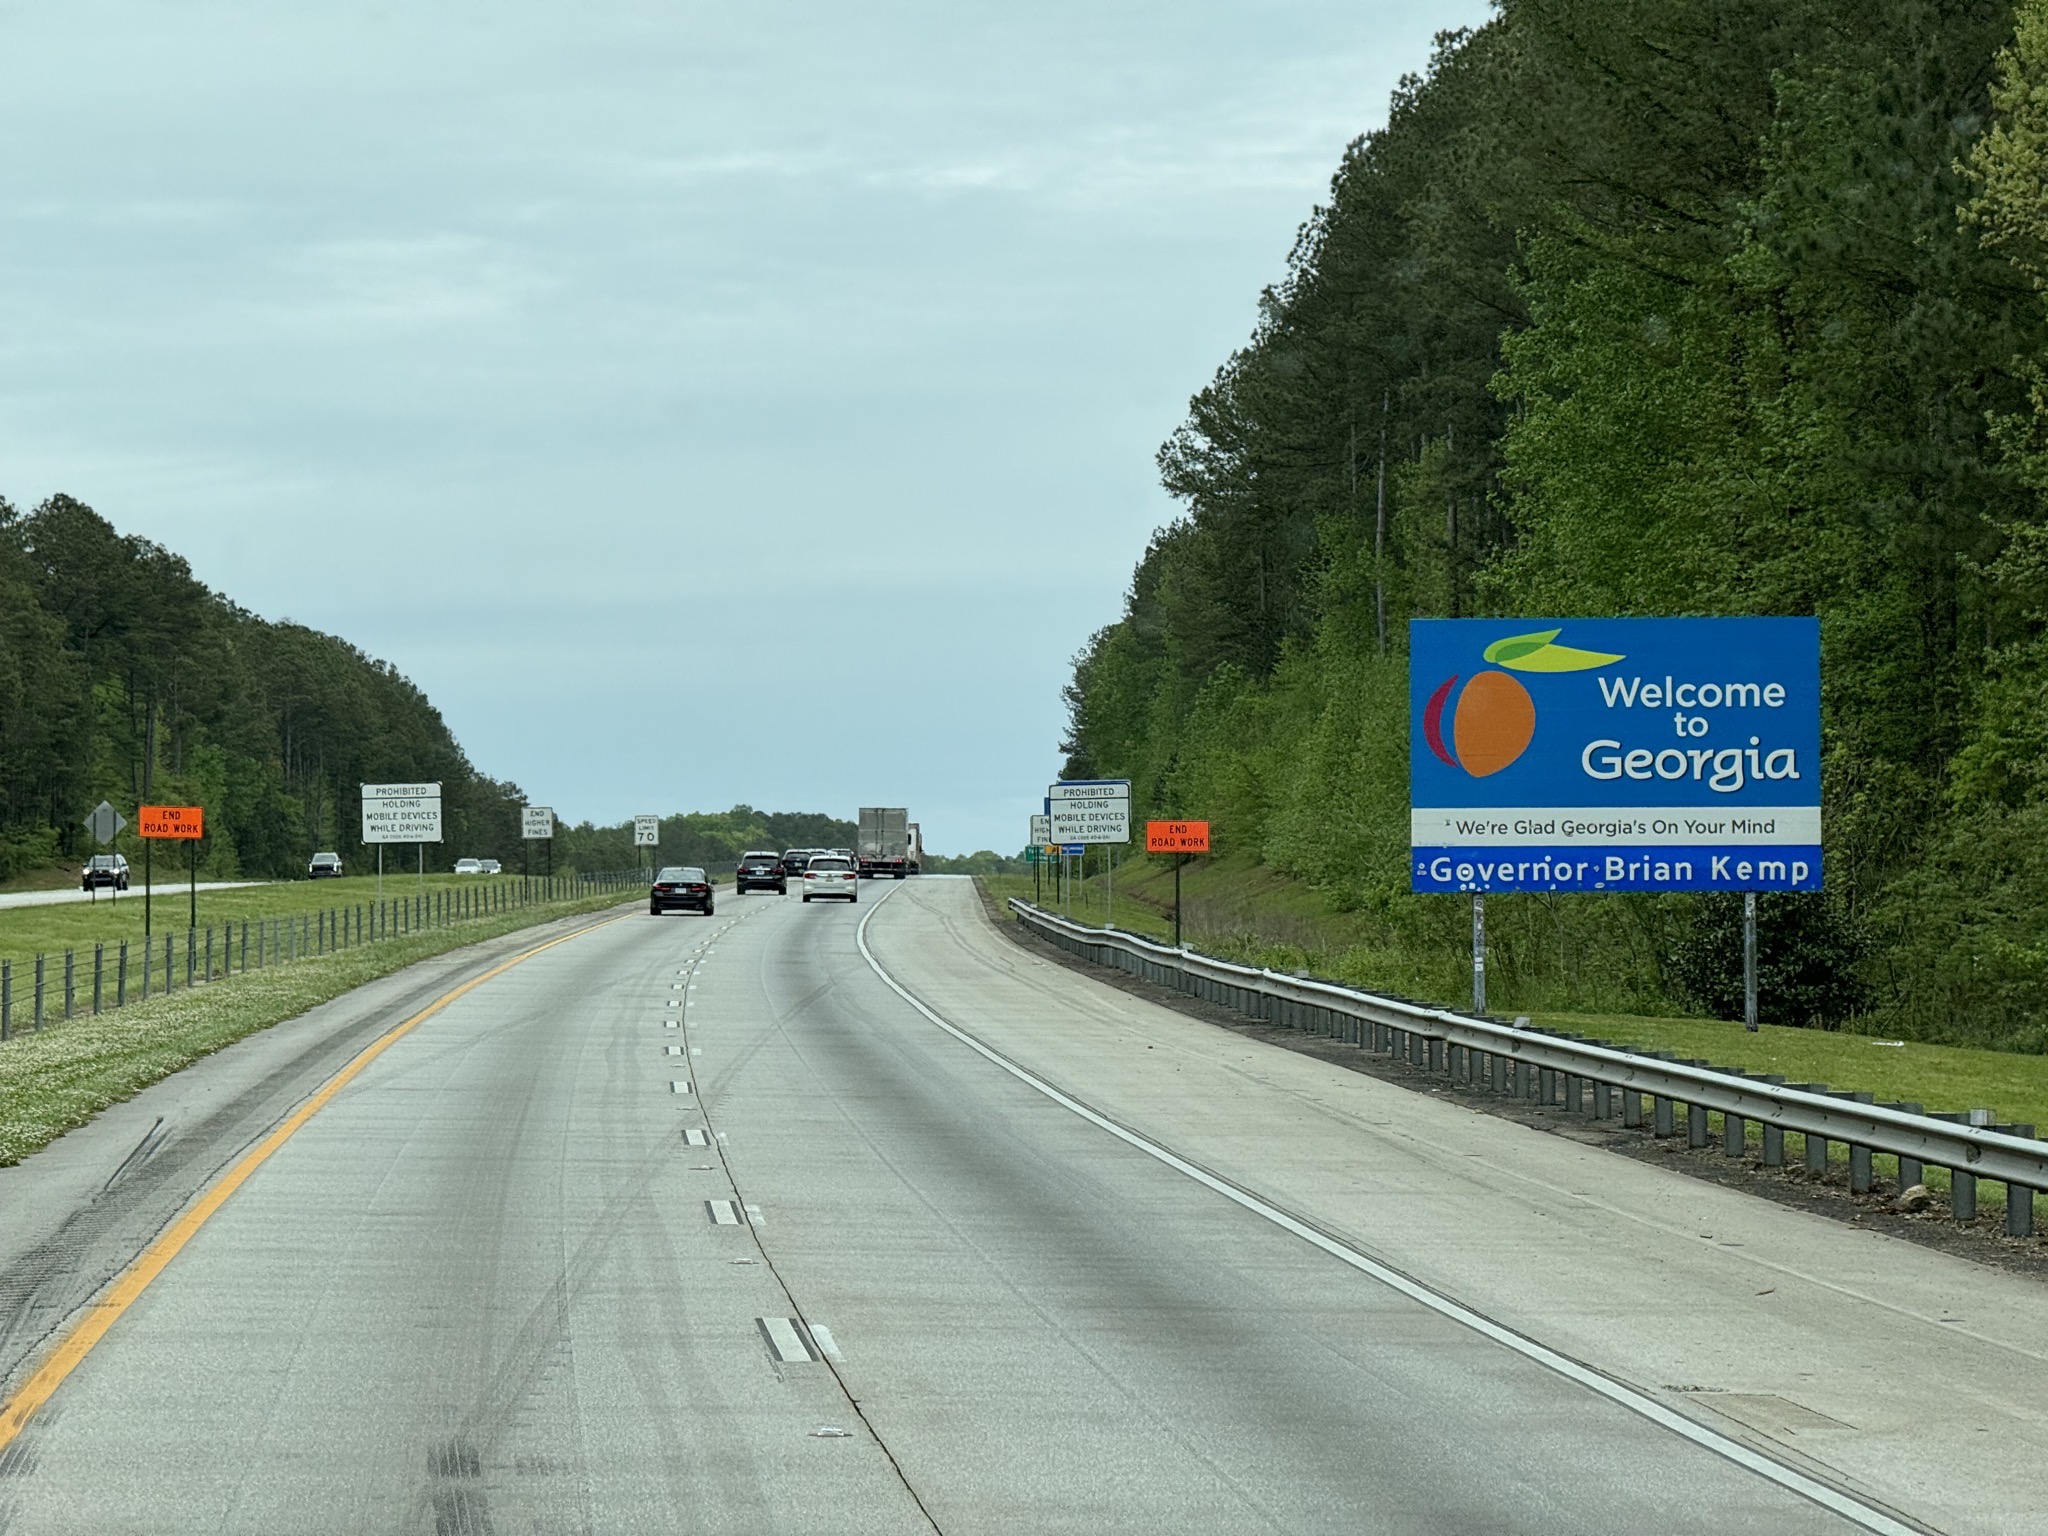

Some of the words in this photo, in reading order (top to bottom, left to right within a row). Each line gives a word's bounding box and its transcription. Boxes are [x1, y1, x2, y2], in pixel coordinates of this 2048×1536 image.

[1597, 675, 1786, 708] Welcome
[1674, 712, 1709, 737] to
[1581, 736, 1800, 793] Georgia
[376, 787, 427, 796] PROHIBITED
[1063, 788, 1115, 797] PROHIBITED
[382, 800, 421, 808] HOLDING
[1070, 801, 1109, 810] HOLDING
[162, 810, 181, 820] END
[366, 812, 398, 820] MOBILE
[400, 812, 438, 820] DEVICES
[1054, 814, 1086, 822] MOBILE
[1088, 813, 1126, 821] DEVICES
[144, 823, 168, 833] ROAD
[173, 823, 198, 833] WORK
[370, 824, 396, 832] WHILE
[399, 824, 434, 832] DRIVING
[1058, 826, 1085, 834] WHILE
[1087, 825, 1122, 833] DRIVING
[1169, 825, 1187, 834] END
[1456, 820, 1508, 835] We're
[1514, 819, 1555, 835] Glad
[1561, 819, 1647, 837] Georgia's
[1652, 819, 1678, 834] On
[1684, 819, 1726, 834] Your
[1732, 819, 1775, 834] Mind
[637, 832, 655, 842] 70
[1152, 838, 1176, 847] ROAD
[1180, 838, 1205, 847] WORK
[1430, 856, 1588, 882] Governor
[1605, 855, 1693, 881] Brian
[1711, 856, 1809, 886] Kemp
